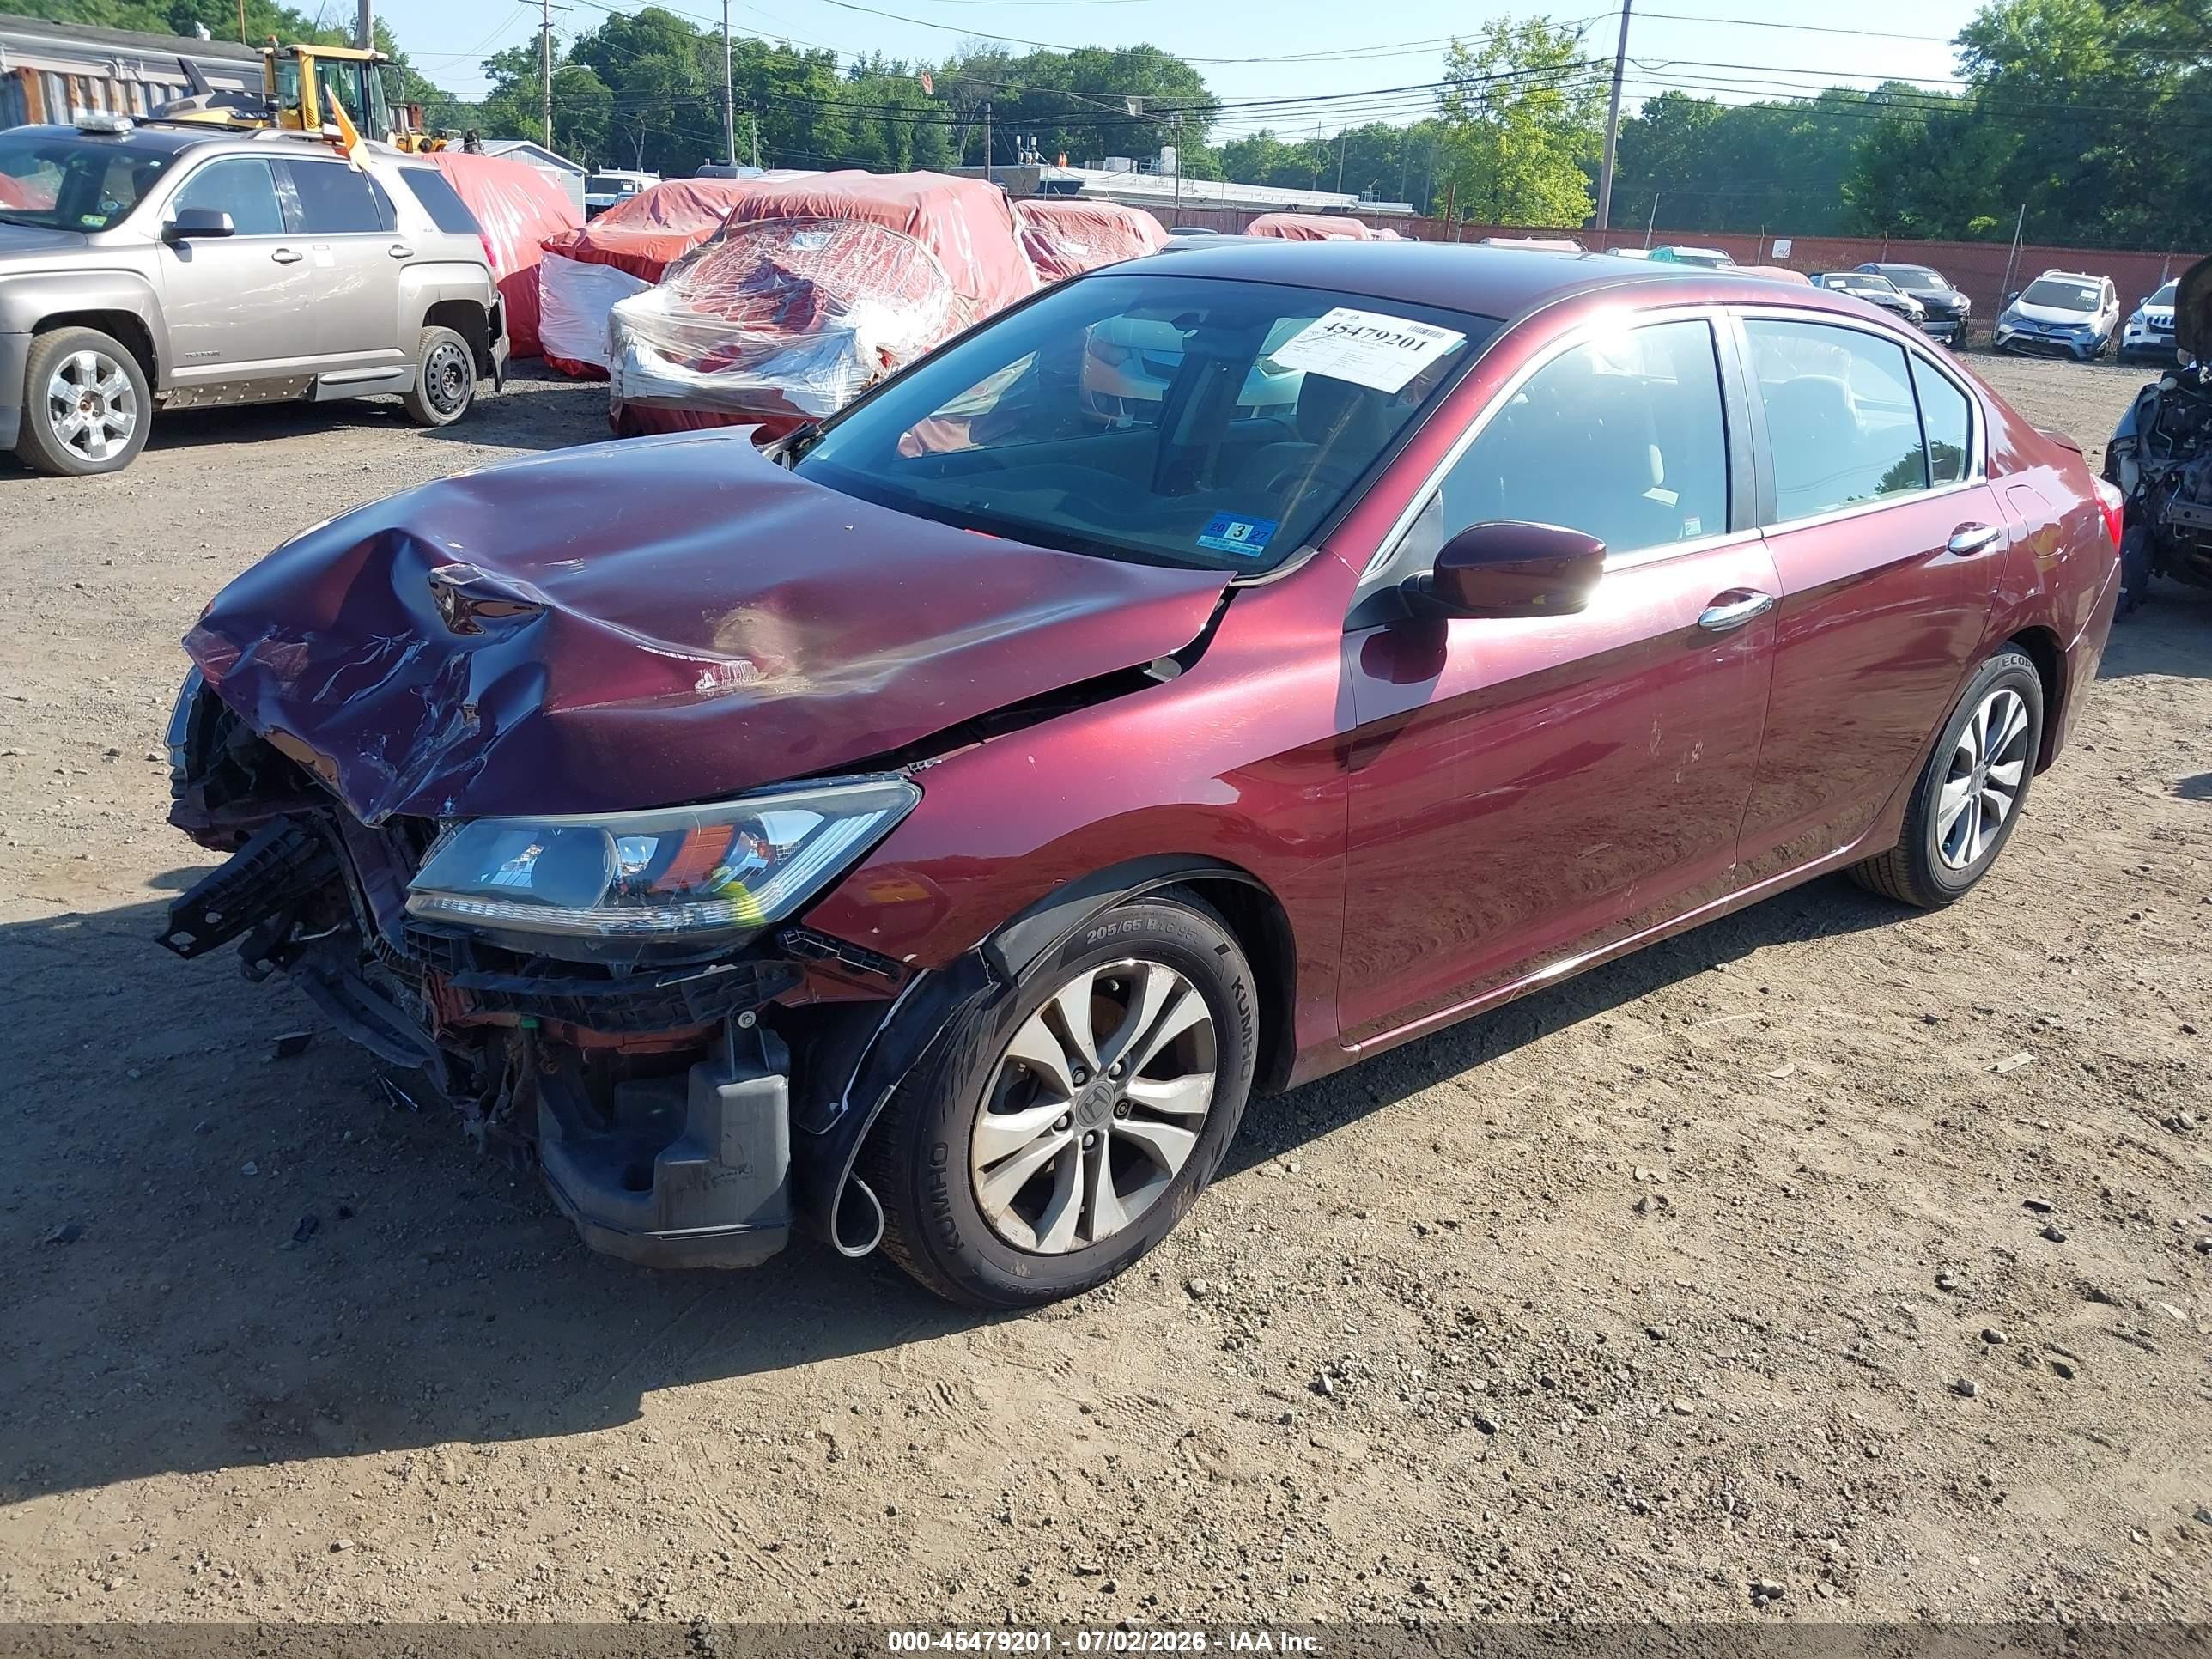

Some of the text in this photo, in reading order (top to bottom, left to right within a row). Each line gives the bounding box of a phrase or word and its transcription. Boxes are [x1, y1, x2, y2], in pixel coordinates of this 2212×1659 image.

[1323, 322, 1428, 351] 45479201
[1209, 522, 1268, 540] 20 3 27
[1086, 919, 1142, 944] 205/65
[1231, 975, 1253, 1082] KUMHO
[928, 1142, 966, 1250] KUMHO
